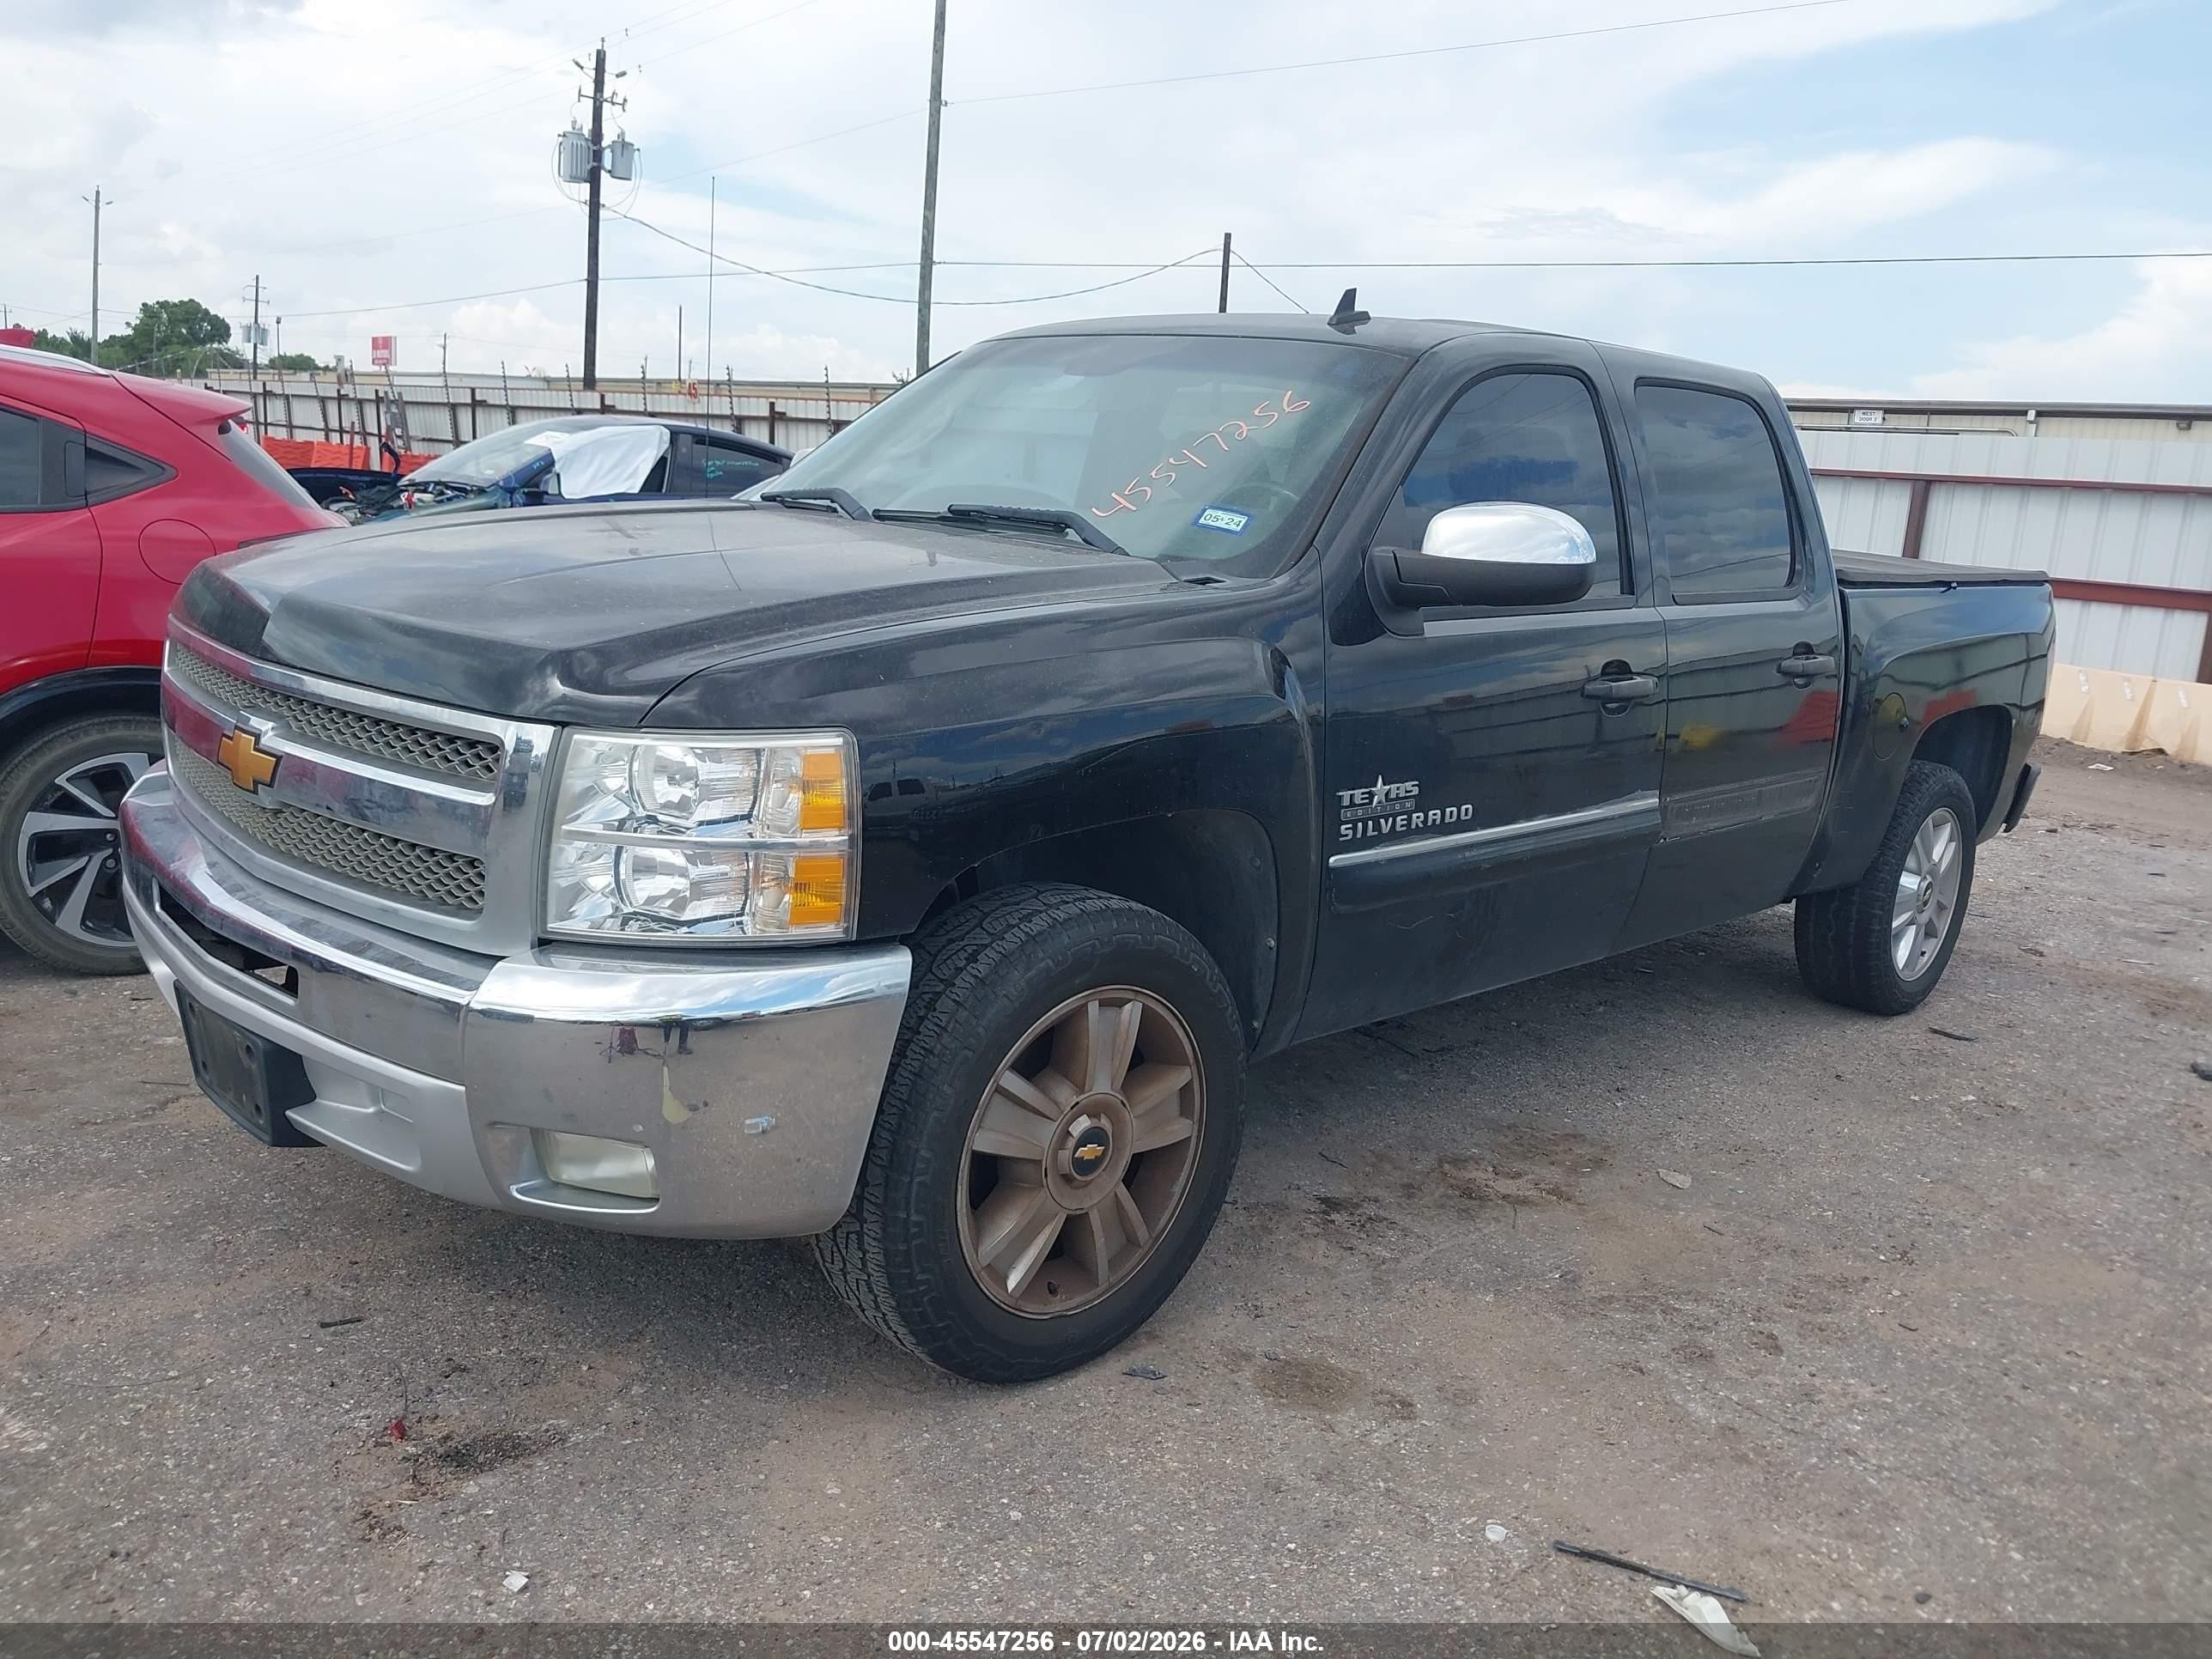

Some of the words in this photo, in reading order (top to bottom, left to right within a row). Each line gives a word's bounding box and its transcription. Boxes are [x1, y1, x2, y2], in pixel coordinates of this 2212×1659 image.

[1091, 390, 1311, 517] 45547256
[1336, 775, 1419, 808] TEXAS
[1346, 800, 1413, 817] EDITION
[1339, 804, 1473, 842] SILVERADO
